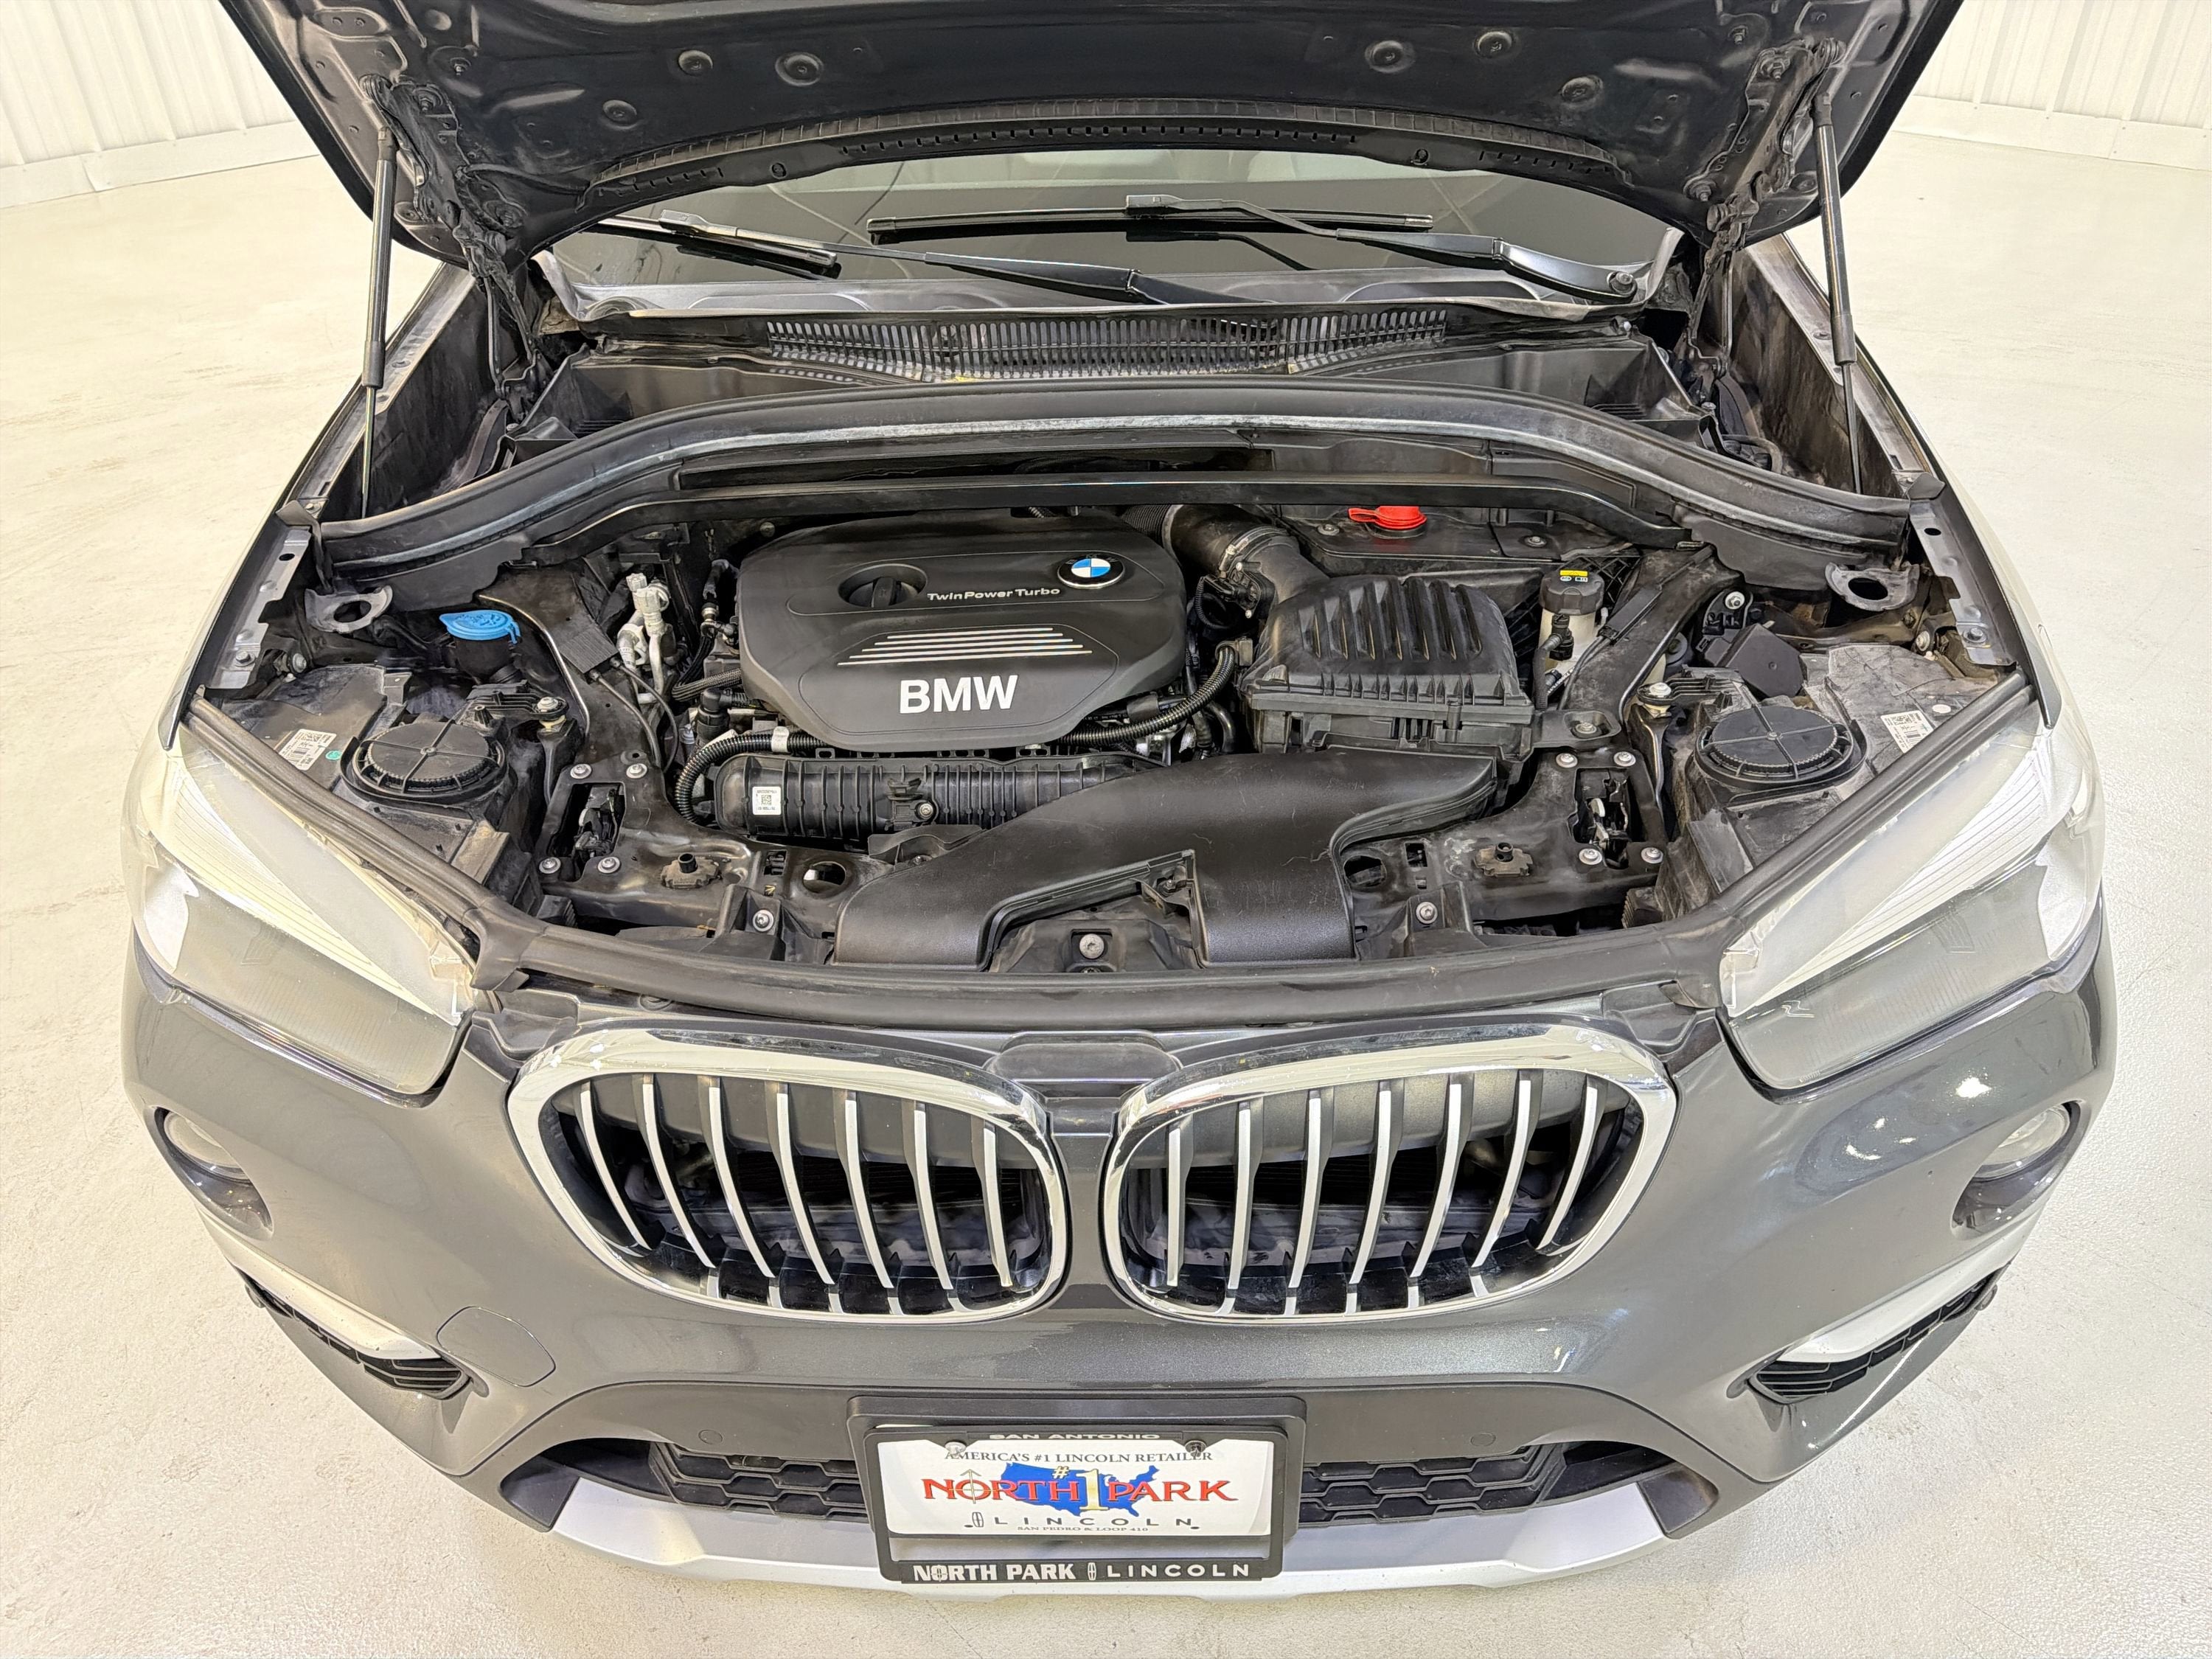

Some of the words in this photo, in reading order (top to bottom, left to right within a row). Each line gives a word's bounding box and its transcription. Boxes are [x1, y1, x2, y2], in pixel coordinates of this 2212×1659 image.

[1015, 588, 1060, 597] Turbo
[900, 675, 1018, 714] BMW
[945, 1451, 1030, 1462] AMERICA'S
[1034, 1453, 1051, 1462] #1
[1056, 1453, 1130, 1463] LINCOLN
[1135, 1451, 1213, 1463] RETAILER
[920, 1478, 1081, 1502] NORTH
[1107, 1479, 1239, 1502] PARK
[994, 1517, 1192, 1526] LINCOLN
[912, 1564, 998, 1582] NORTH
[1006, 1563, 1077, 1580] PARK
[1107, 1563, 1250, 1578] LINCOLN
